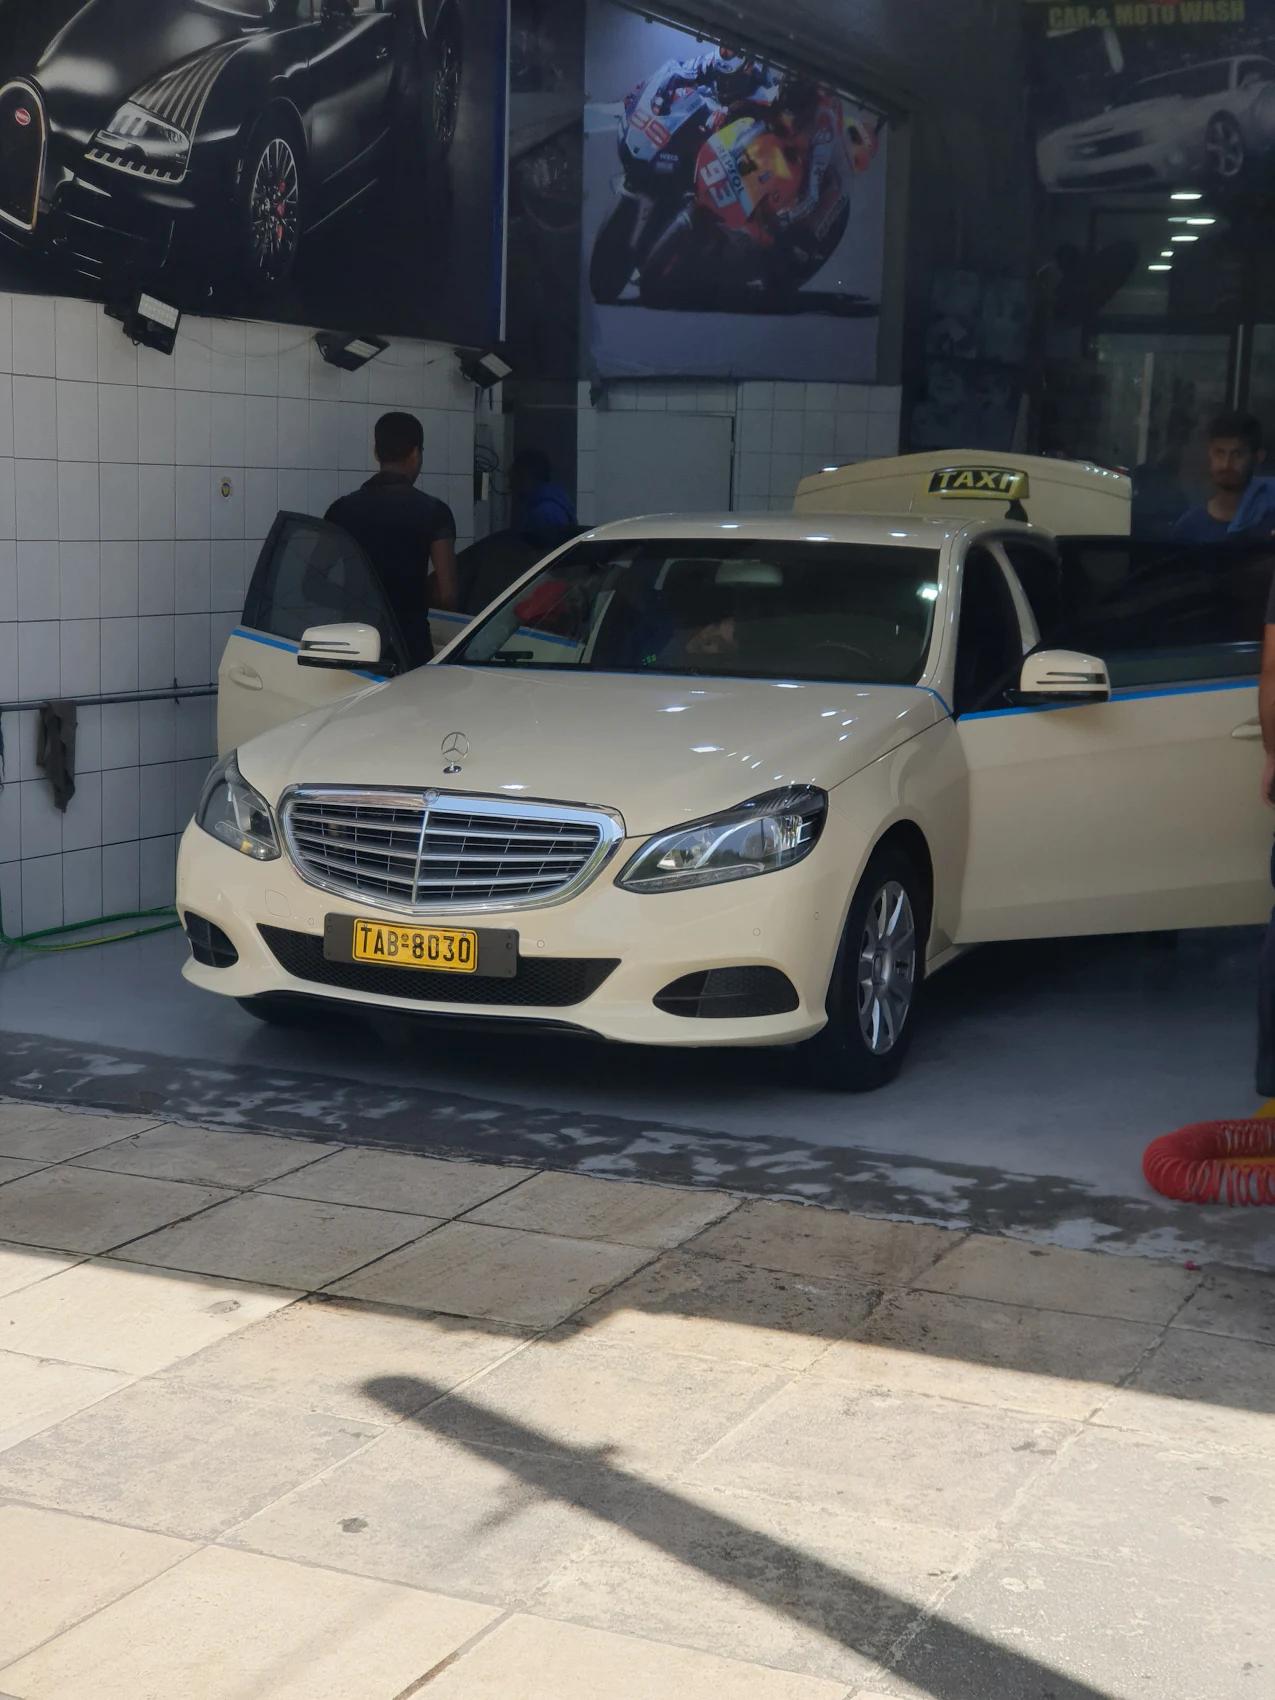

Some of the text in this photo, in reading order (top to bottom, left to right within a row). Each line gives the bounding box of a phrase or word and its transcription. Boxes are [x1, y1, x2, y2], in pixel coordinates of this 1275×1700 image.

[1048, 6, 1090, 28] CAR
[1114, 4, 1176, 26] MOTO
[1180, 1, 1245, 23] WASH
[699, 159, 738, 209] 93
[719, 145, 745, 194] REPSOL
[938, 471, 1010, 490] TAXI
